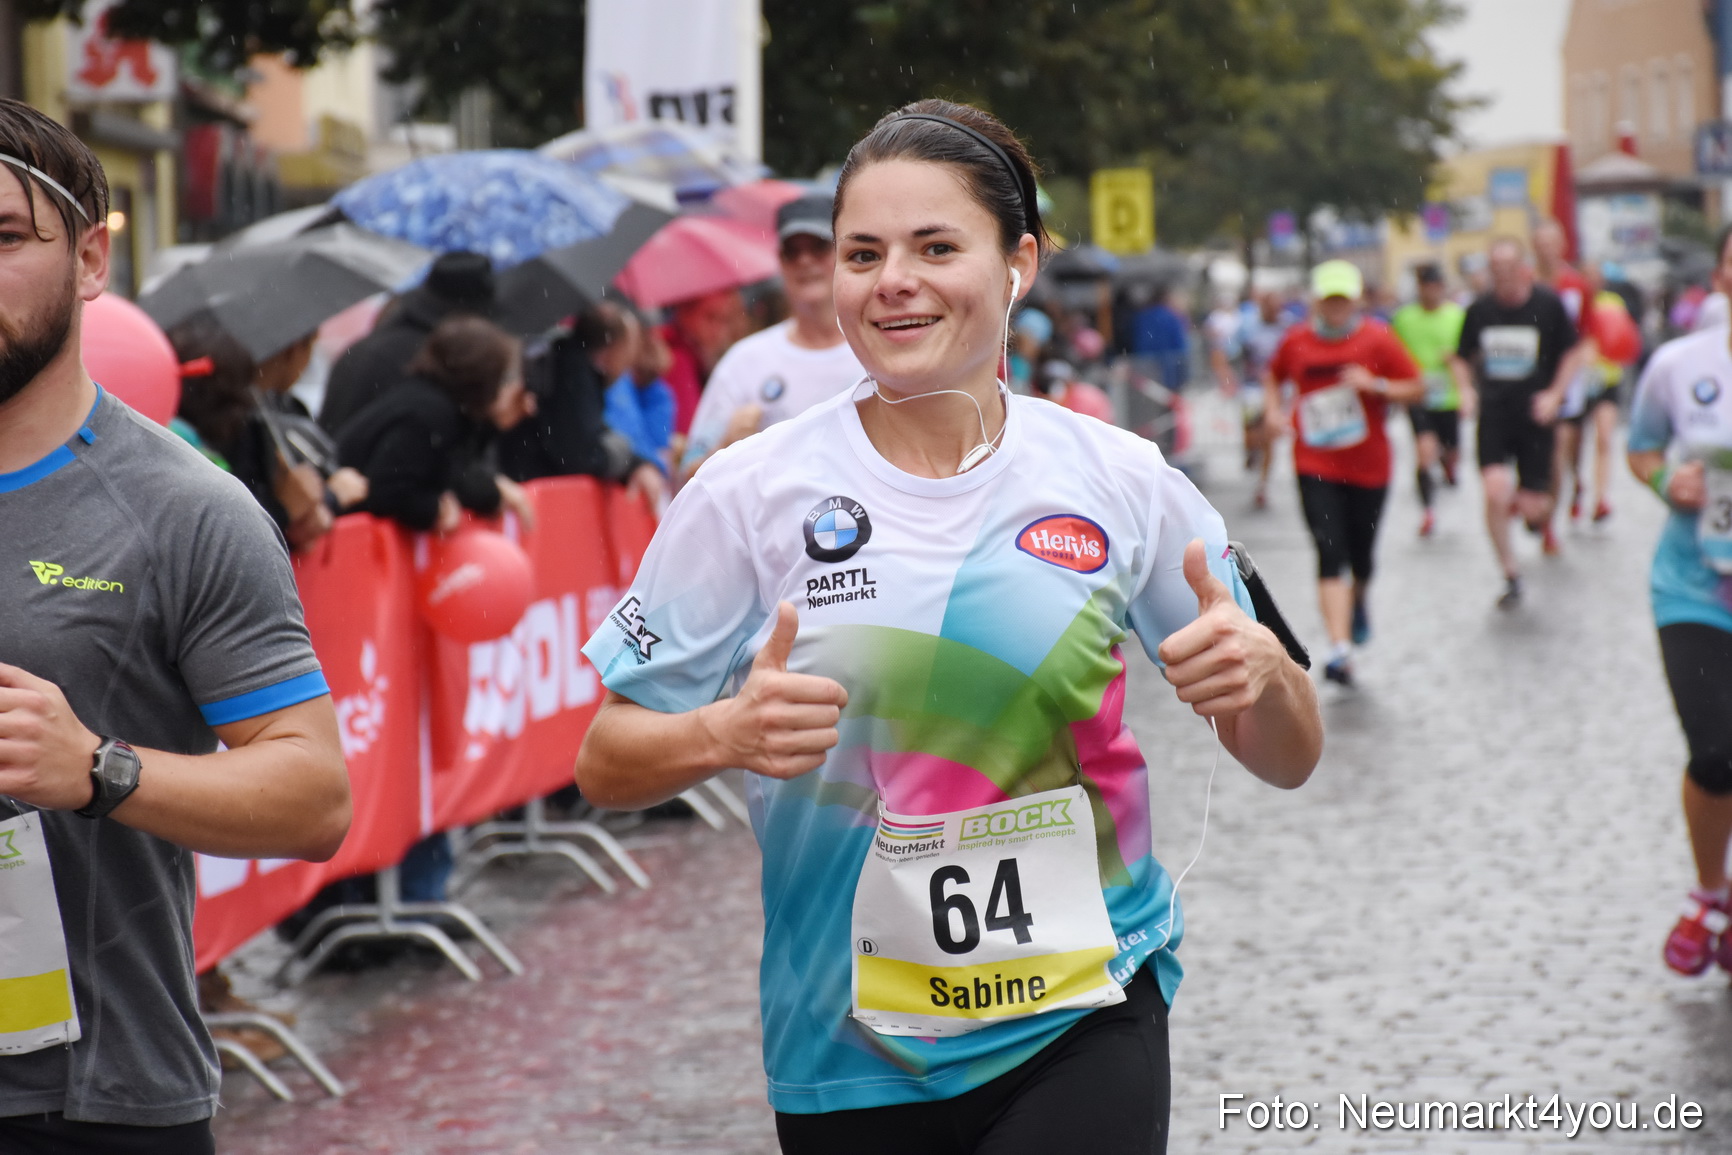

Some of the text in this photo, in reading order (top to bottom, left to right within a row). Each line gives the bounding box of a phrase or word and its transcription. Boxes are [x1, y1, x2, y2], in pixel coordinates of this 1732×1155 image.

[807, 498, 865, 522] BMW
[1030, 529, 1101, 558] Hervis
[1040, 550, 1075, 560] SPORTS
[61, 577, 124, 593] edition
[806, 567, 877, 596] PARTL
[807, 587, 877, 610] Neumarkt
[958, 798, 1074, 842] BOCK
[875, 835, 946, 855] NeuerMarkt
[957, 828, 1077, 852] inspired by smart concepts
[929, 858, 1034, 955] 64
[863, 940, 873, 953] D
[929, 973, 1047, 1010] Sabine
